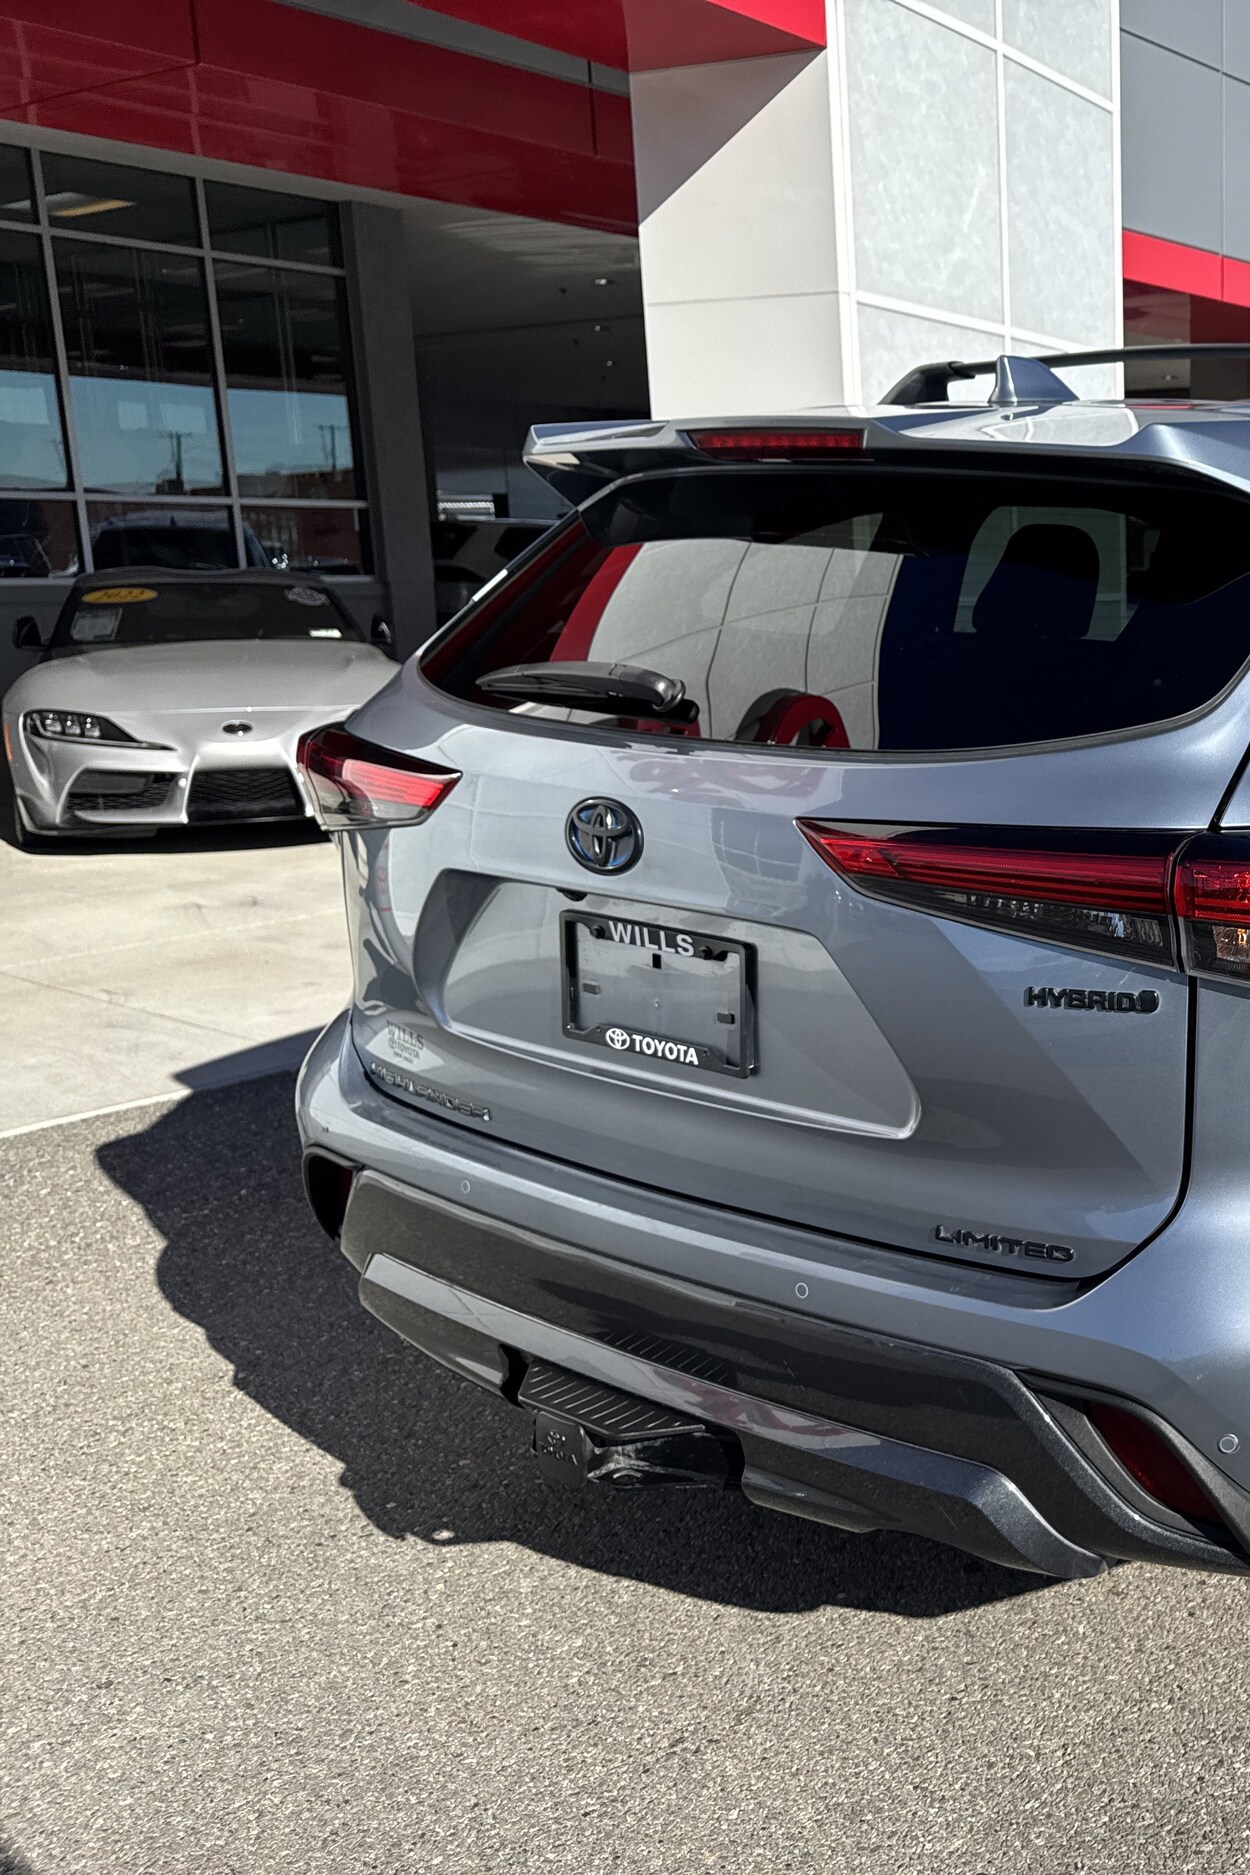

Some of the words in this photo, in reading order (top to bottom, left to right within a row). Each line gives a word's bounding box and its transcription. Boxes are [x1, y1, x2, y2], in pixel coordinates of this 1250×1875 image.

[609, 921, 695, 957] WILLS
[1023, 986, 1138, 1013] HYBRID
[386, 1020, 424, 1050] WILLS
[632, 1034, 699, 1065] TOYOTA
[397, 1042, 420, 1060] TOYOTA
[934, 1225, 1075, 1262] LIMITED
